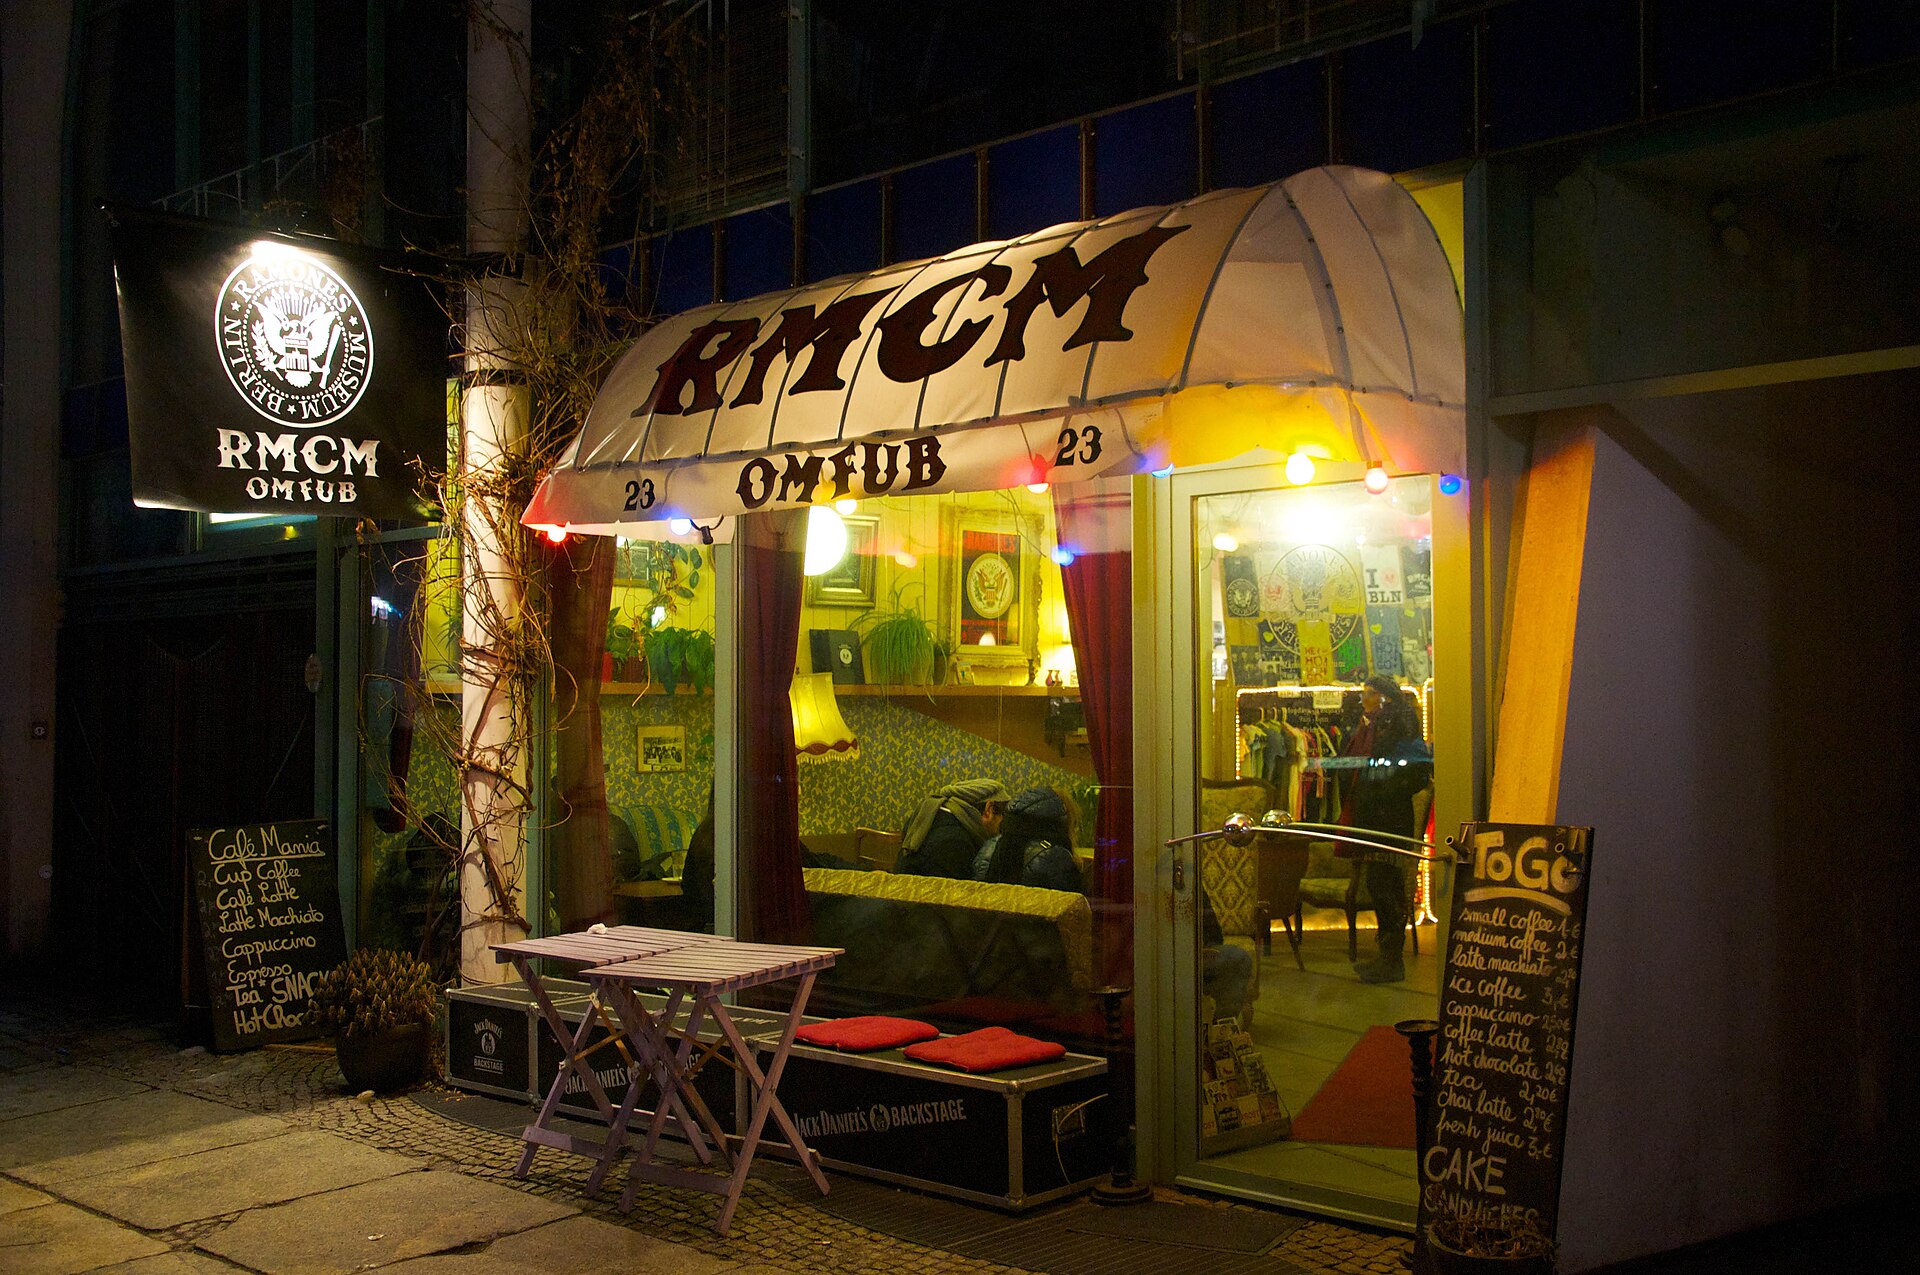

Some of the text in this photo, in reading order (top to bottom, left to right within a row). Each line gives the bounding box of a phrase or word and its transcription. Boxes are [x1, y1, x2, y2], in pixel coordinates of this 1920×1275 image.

[631, 224, 1192, 417] RMCM
[223, 260, 366, 420] RAMONES MUSEUM BERLIN
[216, 427, 380, 478] RMCM
[1056, 425, 1102, 466] 23
[736, 436, 947, 508] OMFUB
[245, 476, 357, 503] OMFUB
[624, 477, 655, 511] 23
[1368, 590, 1401, 604] BLN
[208, 825, 322, 870] Café Mania
[214, 859, 302, 893] Cup Coffee
[216, 881, 300, 915] Café Latte
[218, 903, 325, 933] Latte Macchiato
[1458, 906, 1507, 927] small
[1509, 909, 1556, 934] coffee
[222, 930, 317, 966] Cappuccino
[1450, 944, 1487, 971] latte
[1488, 953, 1558, 977] macchiato
[1452, 927, 1509, 949] medium
[1510, 930, 1552, 962] coffee
[227, 959, 293, 988] Espresso
[1449, 970, 1475, 994] ice
[1478, 976, 1528, 1007] coffee
[225, 984, 264, 1007] Tea
[233, 1006, 263, 1035] Hot
[1486, 1023, 1534, 1053] latte
[473, 1058, 504, 1072] BACKSTAGE
[592, 1064, 627, 1089] ANIEL'S
[1440, 1040, 1473, 1067] hot
[1474, 1047, 1543, 1081] chocolate
[1442, 1064, 1484, 1091] tea
[793, 1099, 967, 1138] JACK DANIEL'S BACKSTAGE
[1437, 1085, 1473, 1112] chai
[1475, 1088, 1517, 1122] latte
[1436, 1108, 1481, 1145] fresh
[1482, 1125, 1525, 1155] juice
[1423, 1145, 1507, 1195] CAKE
